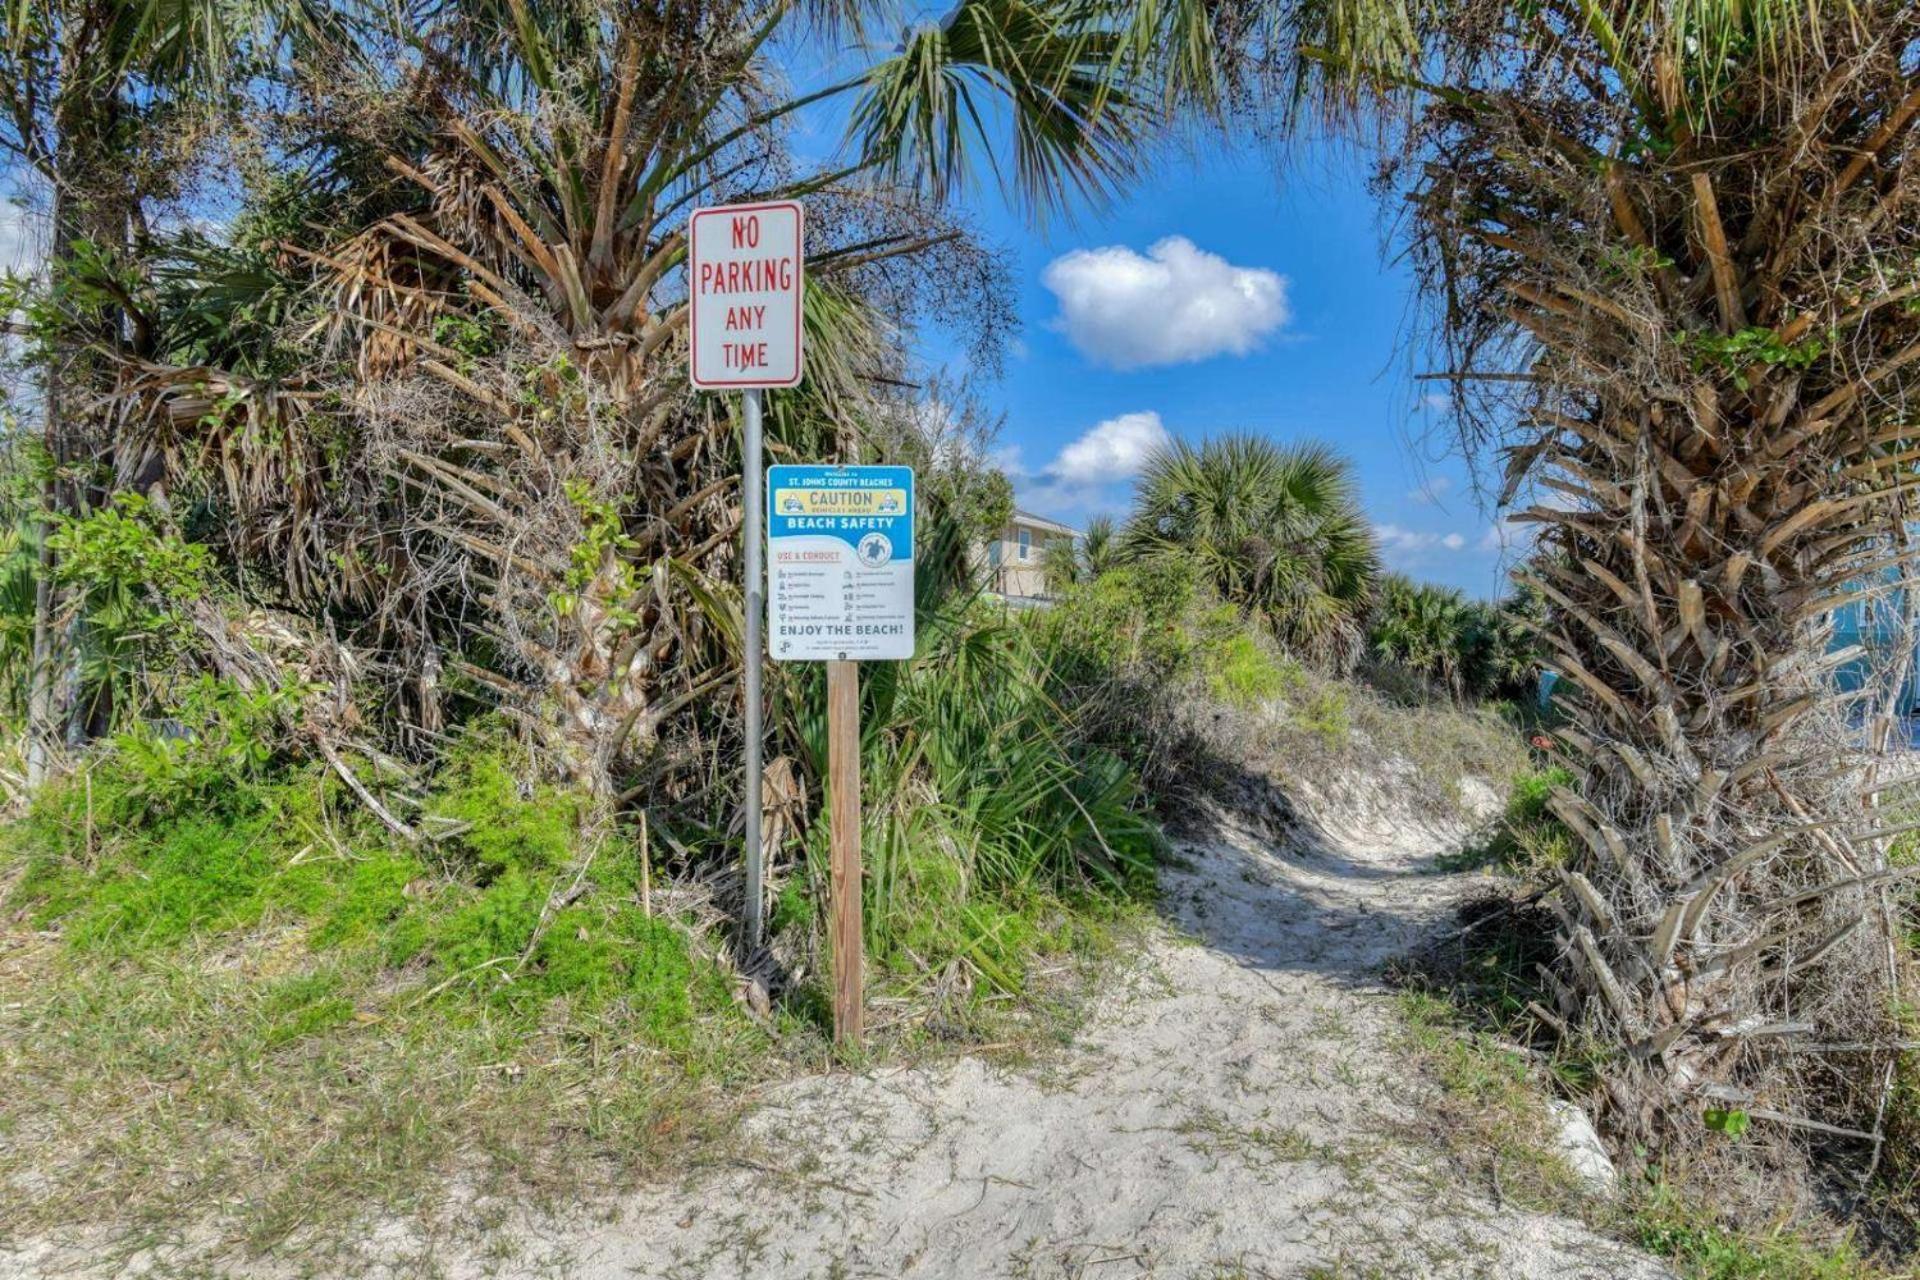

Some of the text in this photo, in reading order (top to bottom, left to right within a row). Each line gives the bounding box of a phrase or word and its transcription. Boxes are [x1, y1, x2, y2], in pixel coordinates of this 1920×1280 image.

[732, 215, 759, 249] NO
[701, 258, 791, 295] PARKING
[726, 305, 766, 331] ANY
[722, 343, 769, 368] TIME
[802, 478, 826, 486] JOHNS
[827, 478, 857, 487] COUNTY
[809, 492, 872, 505] CAUTION
[788, 518, 894, 529] BEACH SAFETY
[778, 552, 793, 560] USE
[803, 552, 841, 560] CONDUCT
[780, 625, 904, 635] ENJOY THE BEACH!
